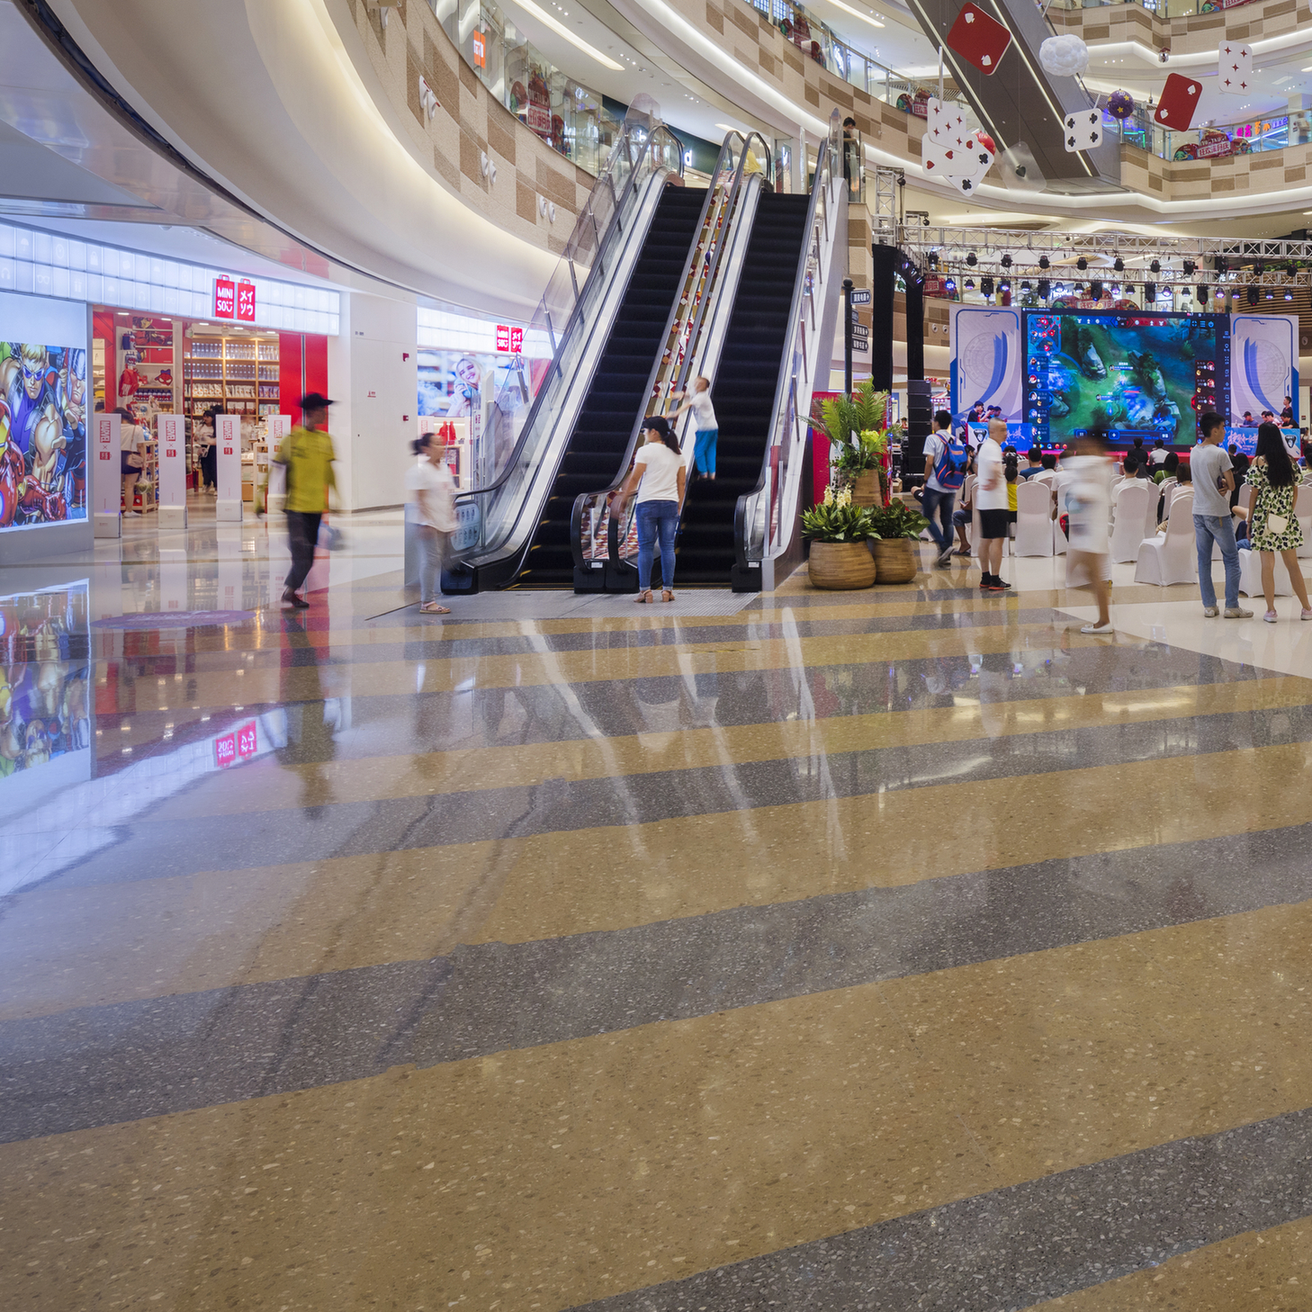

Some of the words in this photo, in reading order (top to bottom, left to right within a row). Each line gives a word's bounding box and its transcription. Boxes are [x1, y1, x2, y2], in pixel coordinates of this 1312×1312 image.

[217, 287, 233, 299] MINI
[239, 290, 253, 302] メイ
[240, 303, 253, 316] ソウ
